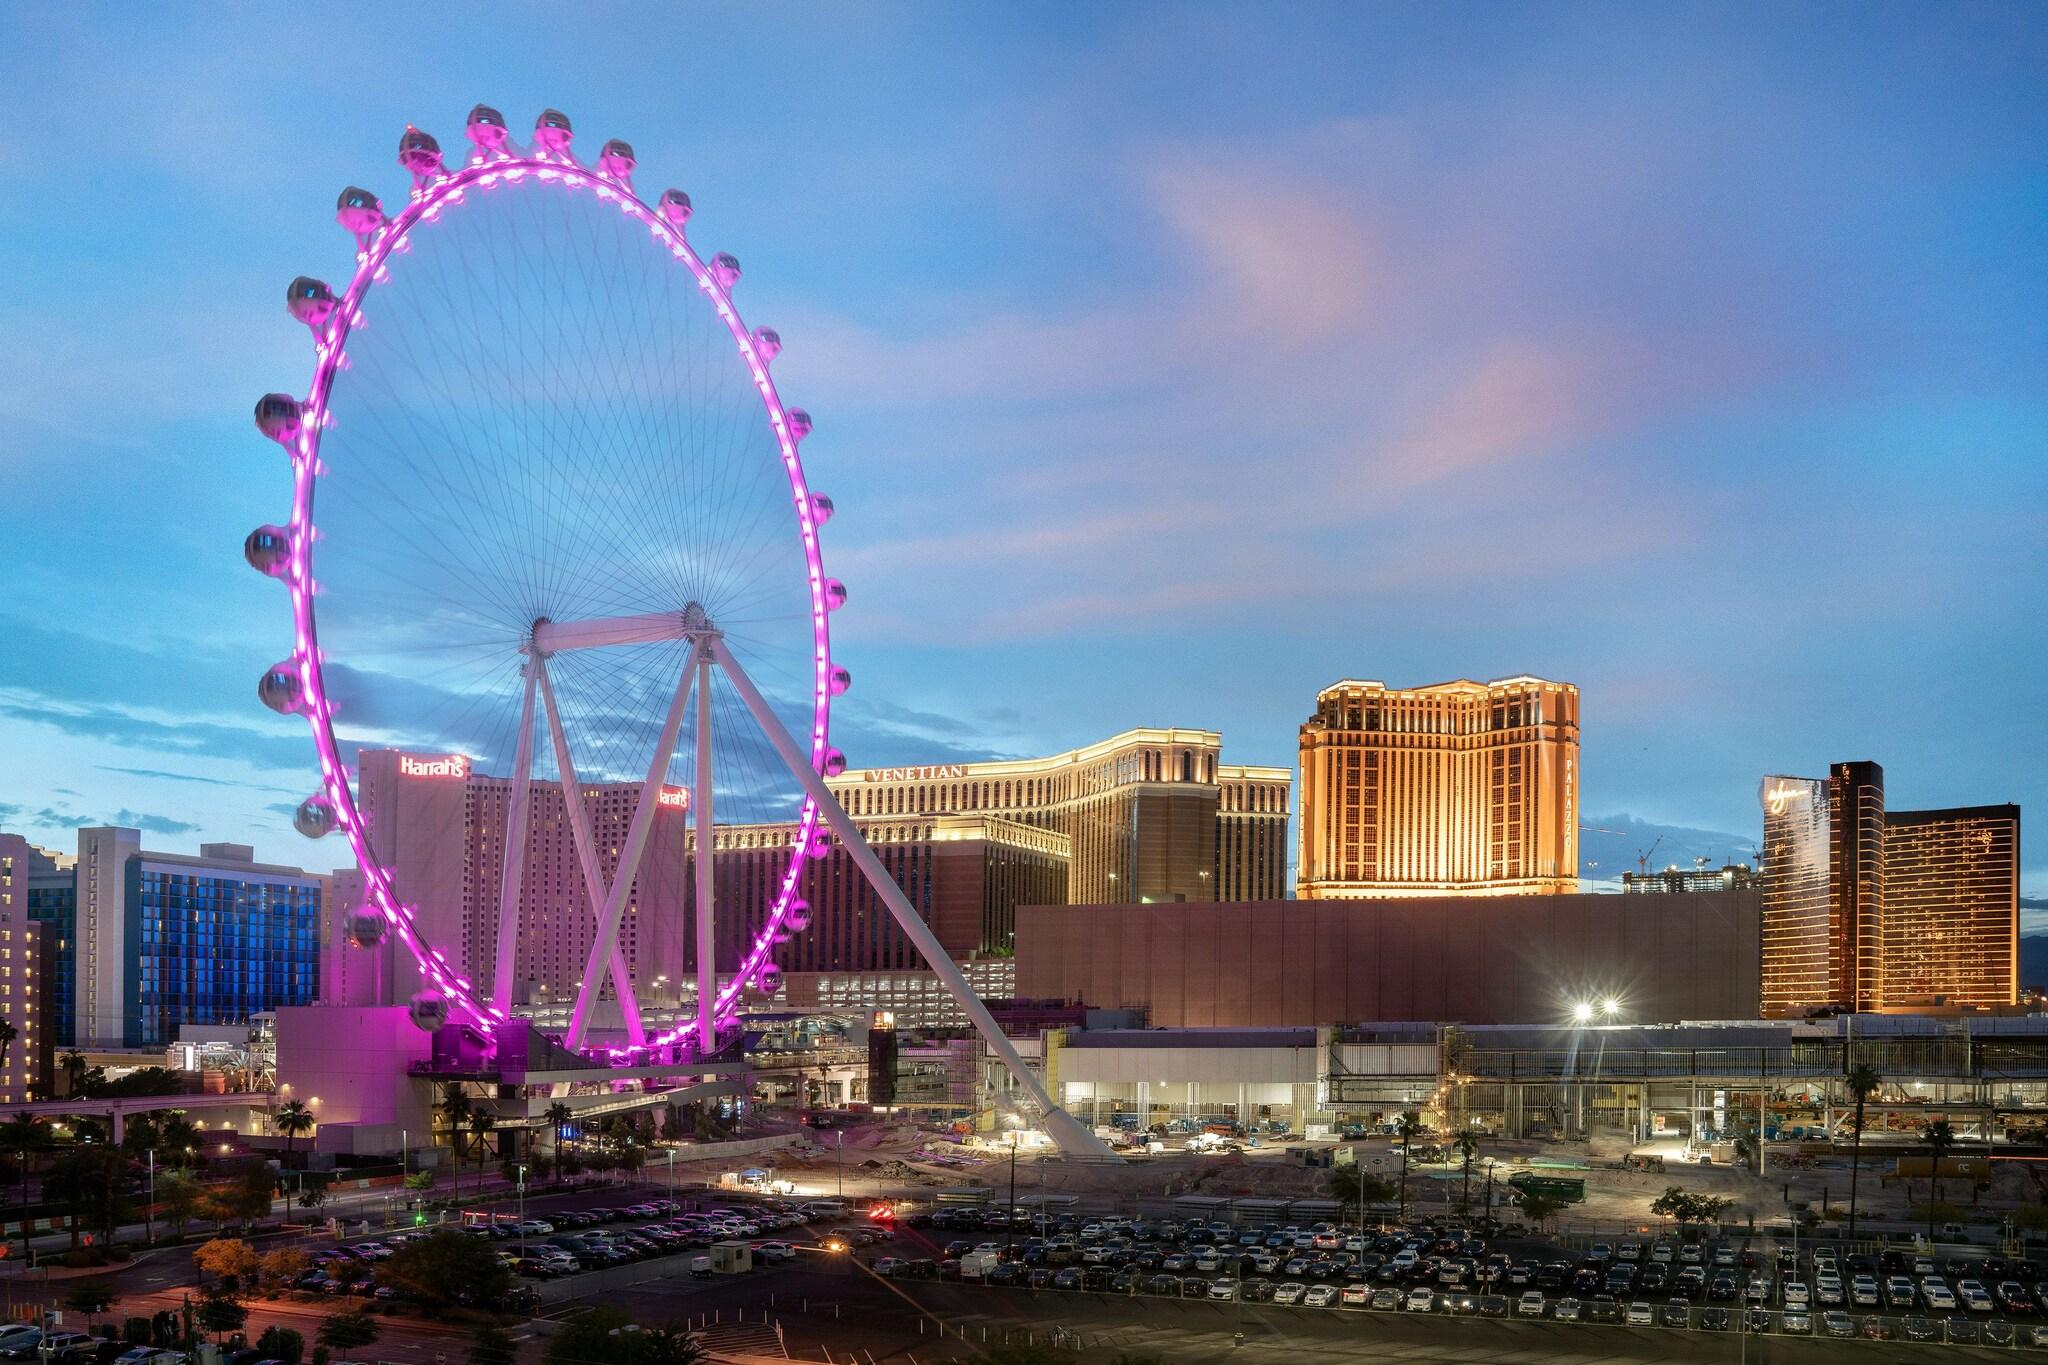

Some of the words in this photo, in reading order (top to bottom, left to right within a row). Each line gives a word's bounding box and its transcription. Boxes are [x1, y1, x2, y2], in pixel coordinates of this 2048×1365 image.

[401, 755, 465, 778] Harrah's
[868, 765, 963, 782] VENETIAN
[1565, 759, 1573, 845] PALAZZO
